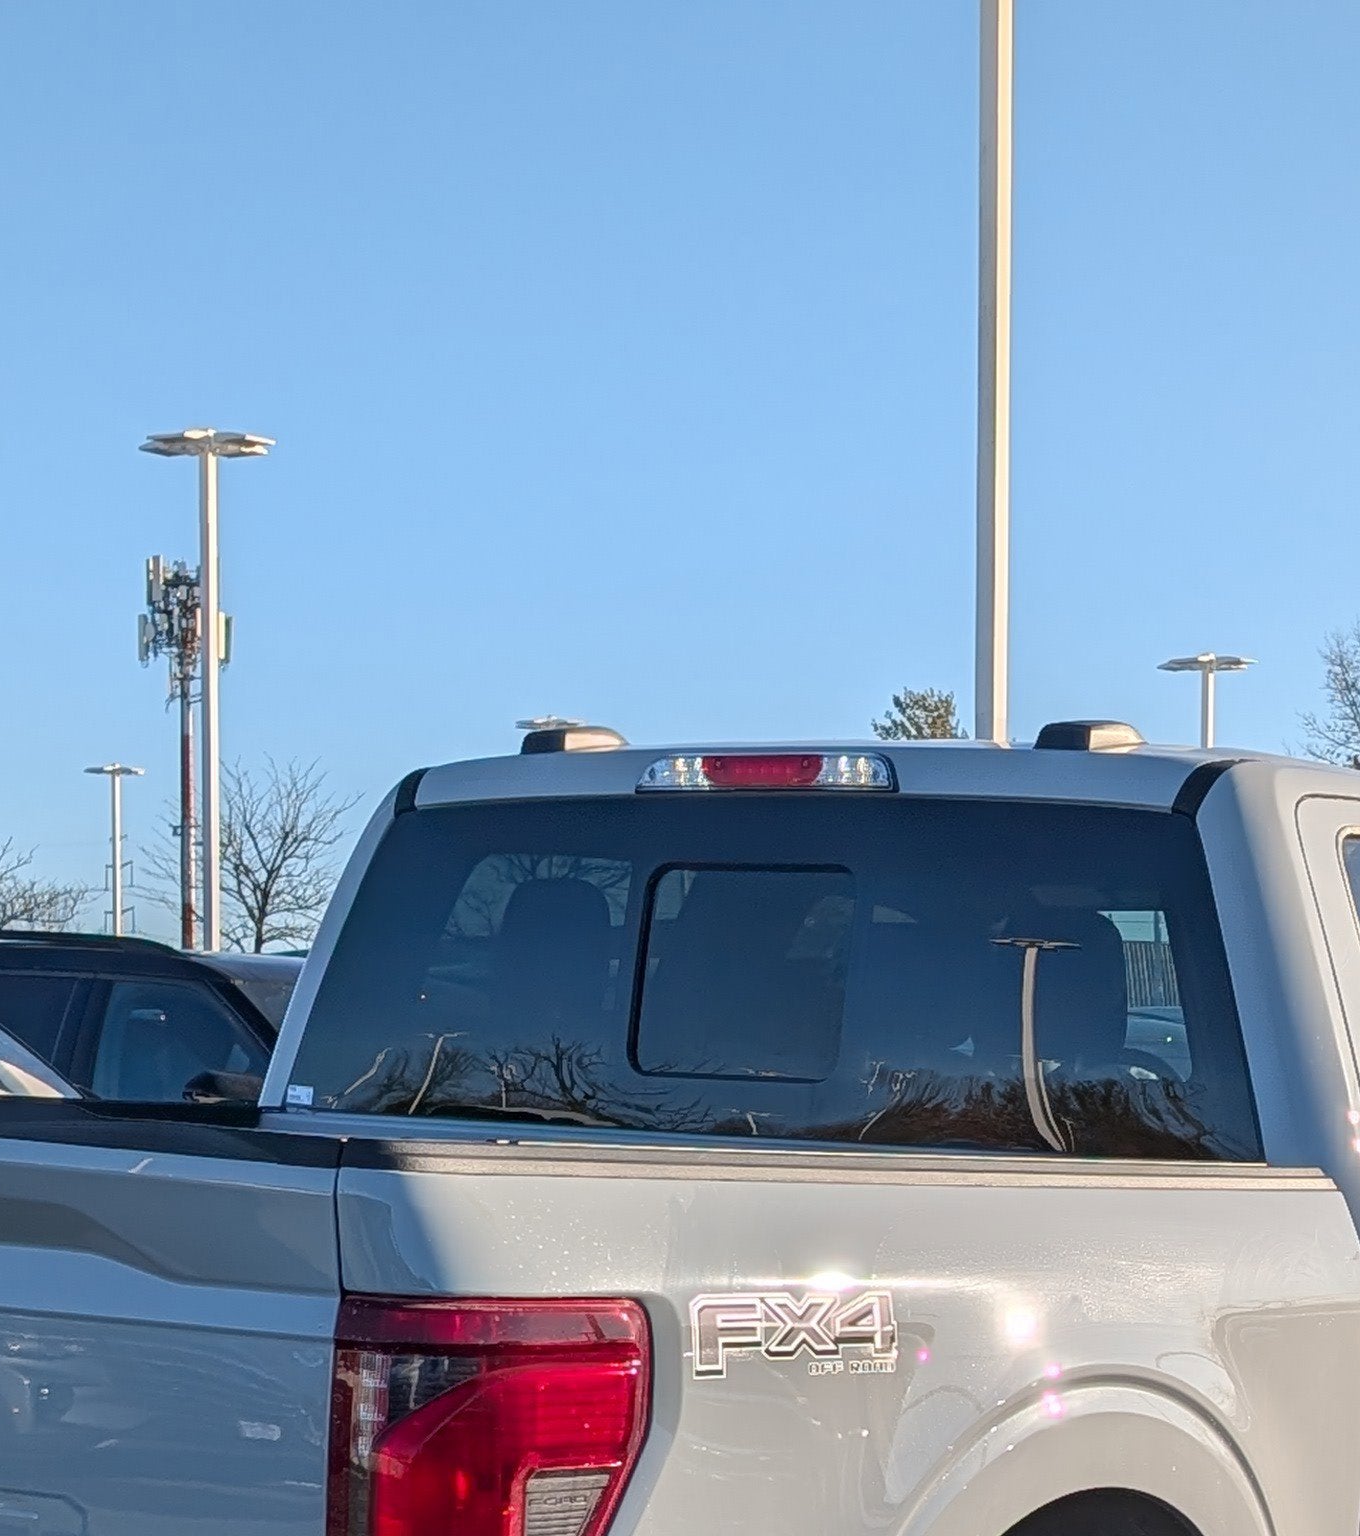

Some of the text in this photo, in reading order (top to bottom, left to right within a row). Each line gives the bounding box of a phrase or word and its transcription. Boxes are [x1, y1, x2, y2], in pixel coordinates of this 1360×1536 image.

[689, 1291, 898, 1380] FX4
[808, 1358, 895, 1376] OFF ROAD
